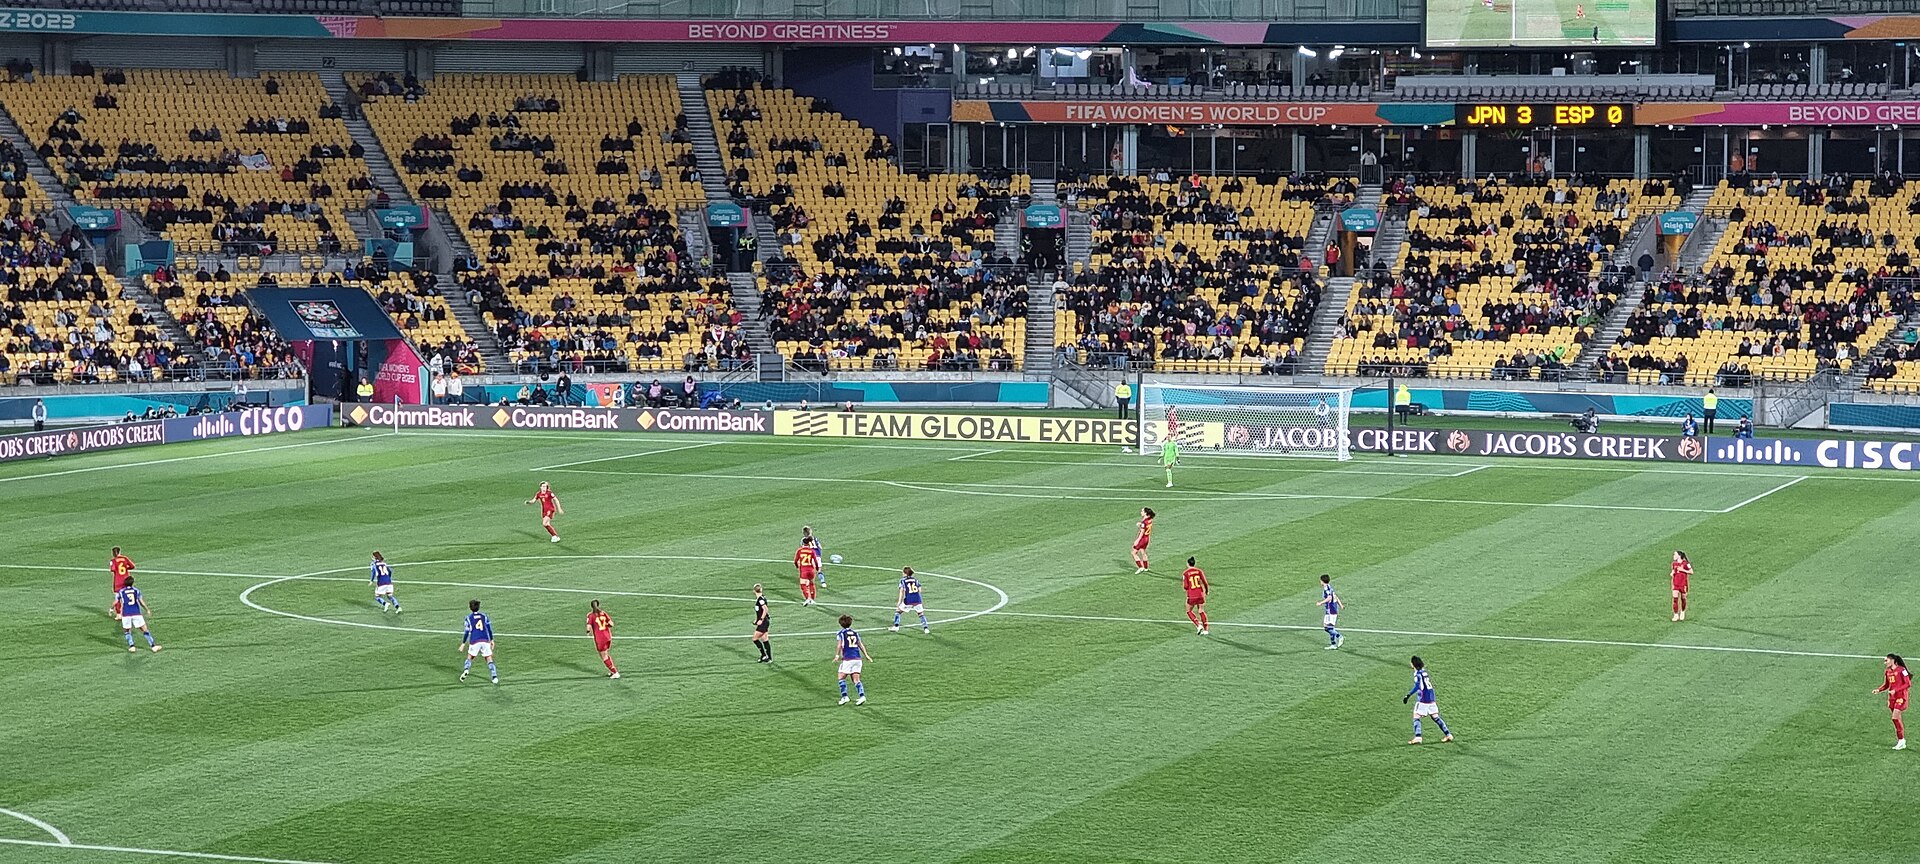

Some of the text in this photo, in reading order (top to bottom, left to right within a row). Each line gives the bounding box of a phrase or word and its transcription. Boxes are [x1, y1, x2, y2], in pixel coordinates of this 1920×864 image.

[688, 24, 767, 39] BEYOND
[1066, 105, 1106, 119] FIFA
[1110, 105, 1204, 120] WOMEN'S
[1209, 106, 1280, 121] WORLD
[1467, 105, 1622, 124] JPN 3 ESP 0
[1789, 105, 1870, 121] BEYOND
[240, 405, 303, 436] CISCO
[369, 405, 475, 427] CommBank
[512, 408, 619, 430] CommBank
[656, 410, 765, 432] CommBank
[838, 413, 1158, 444] TEAM GLOBAL EXPRESS
[25, 433, 66, 456] CREEK
[80, 424, 163, 451] JACOB'S CREEK
[1481, 433, 1577, 458] JACOB'S
[1816, 439, 1920, 470] CISC
[800, 553, 812, 566] 21
[118, 562, 126, 575] 6
[907, 582, 918, 594] 16
[1189, 575, 1201, 589] 10
[126, 593, 136, 606] 3
[475, 619, 484, 631] 4
[847, 635, 858, 648] 12
